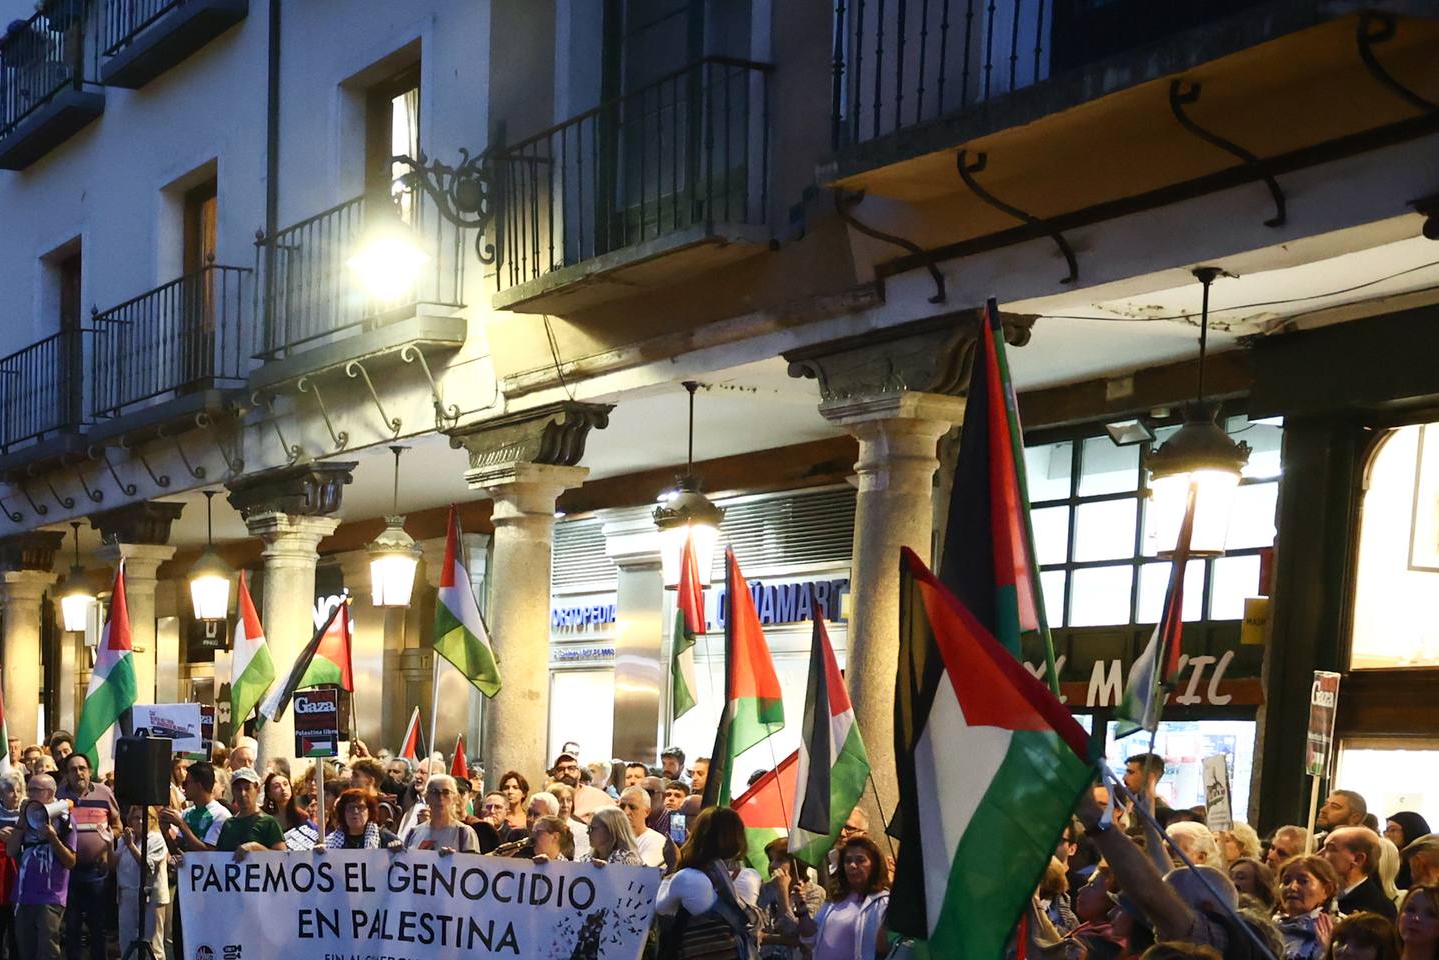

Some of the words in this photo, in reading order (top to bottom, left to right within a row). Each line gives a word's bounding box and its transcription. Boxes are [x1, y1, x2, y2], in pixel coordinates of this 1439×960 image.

[294, 696, 337, 714] Gaza
[190, 862, 335, 893] PAREMOS
[345, 862, 376, 893] EL
[387, 861, 596, 910] GENOCIDIO
[298, 907, 339, 938] EN
[352, 908, 521, 955] PALESTINA
